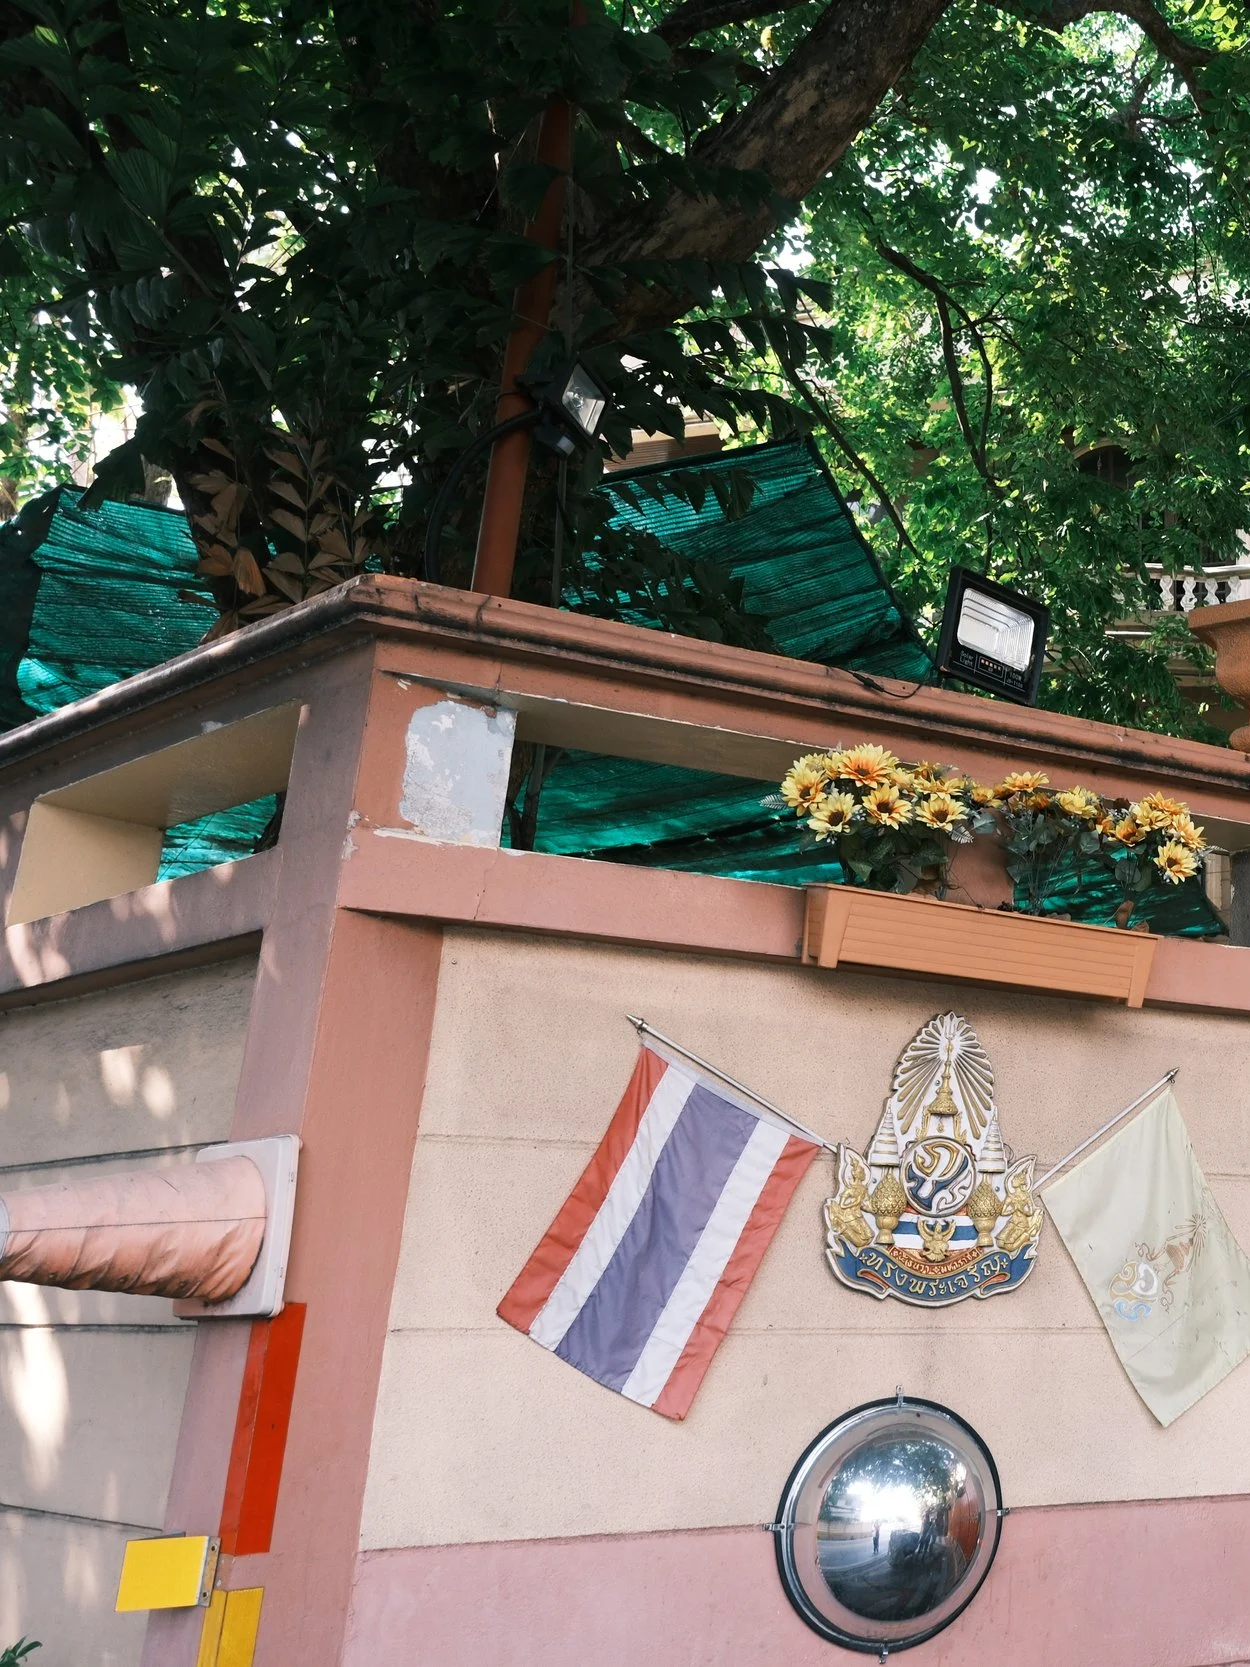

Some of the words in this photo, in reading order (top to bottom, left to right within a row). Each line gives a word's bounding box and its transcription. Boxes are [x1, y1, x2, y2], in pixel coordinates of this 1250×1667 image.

[866, 1251, 1001, 1297] ทรงพระเจริญ
